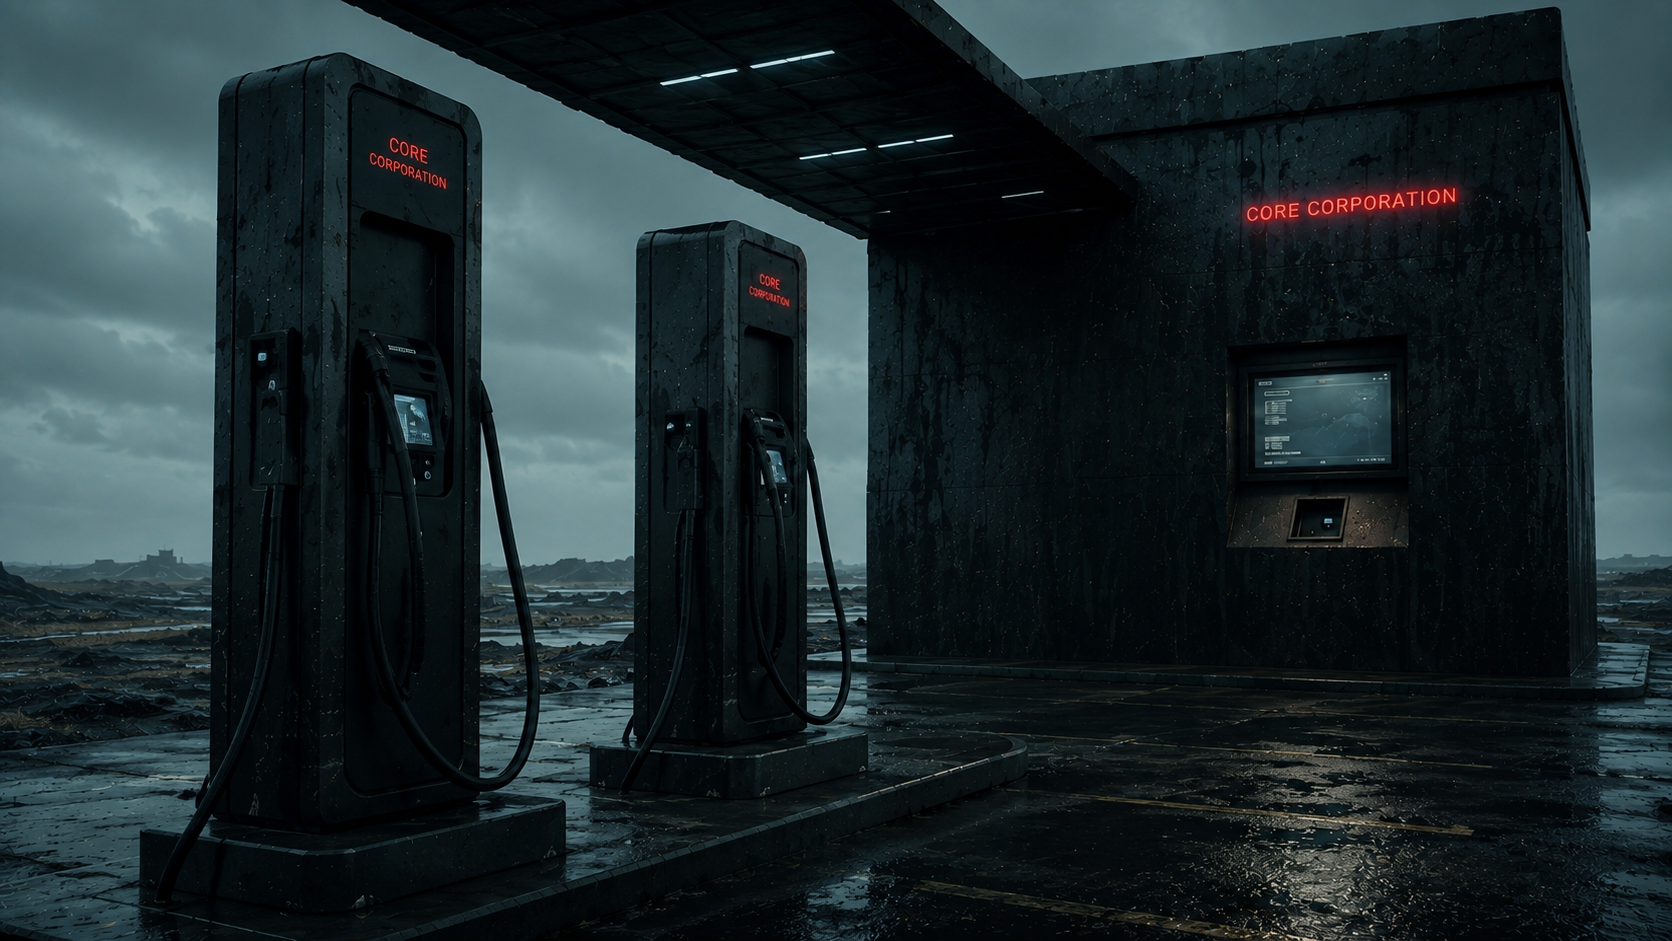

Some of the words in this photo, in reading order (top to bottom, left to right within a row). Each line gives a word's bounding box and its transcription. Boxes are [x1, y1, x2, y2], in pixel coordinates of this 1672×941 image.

[389, 136, 428, 164] CORE
[369, 152, 447, 190] CORPORATION
[1246, 203, 1300, 222] CORE
[1307, 187, 1457, 216] CORPORATION
[759, 273, 781, 291] CORE
